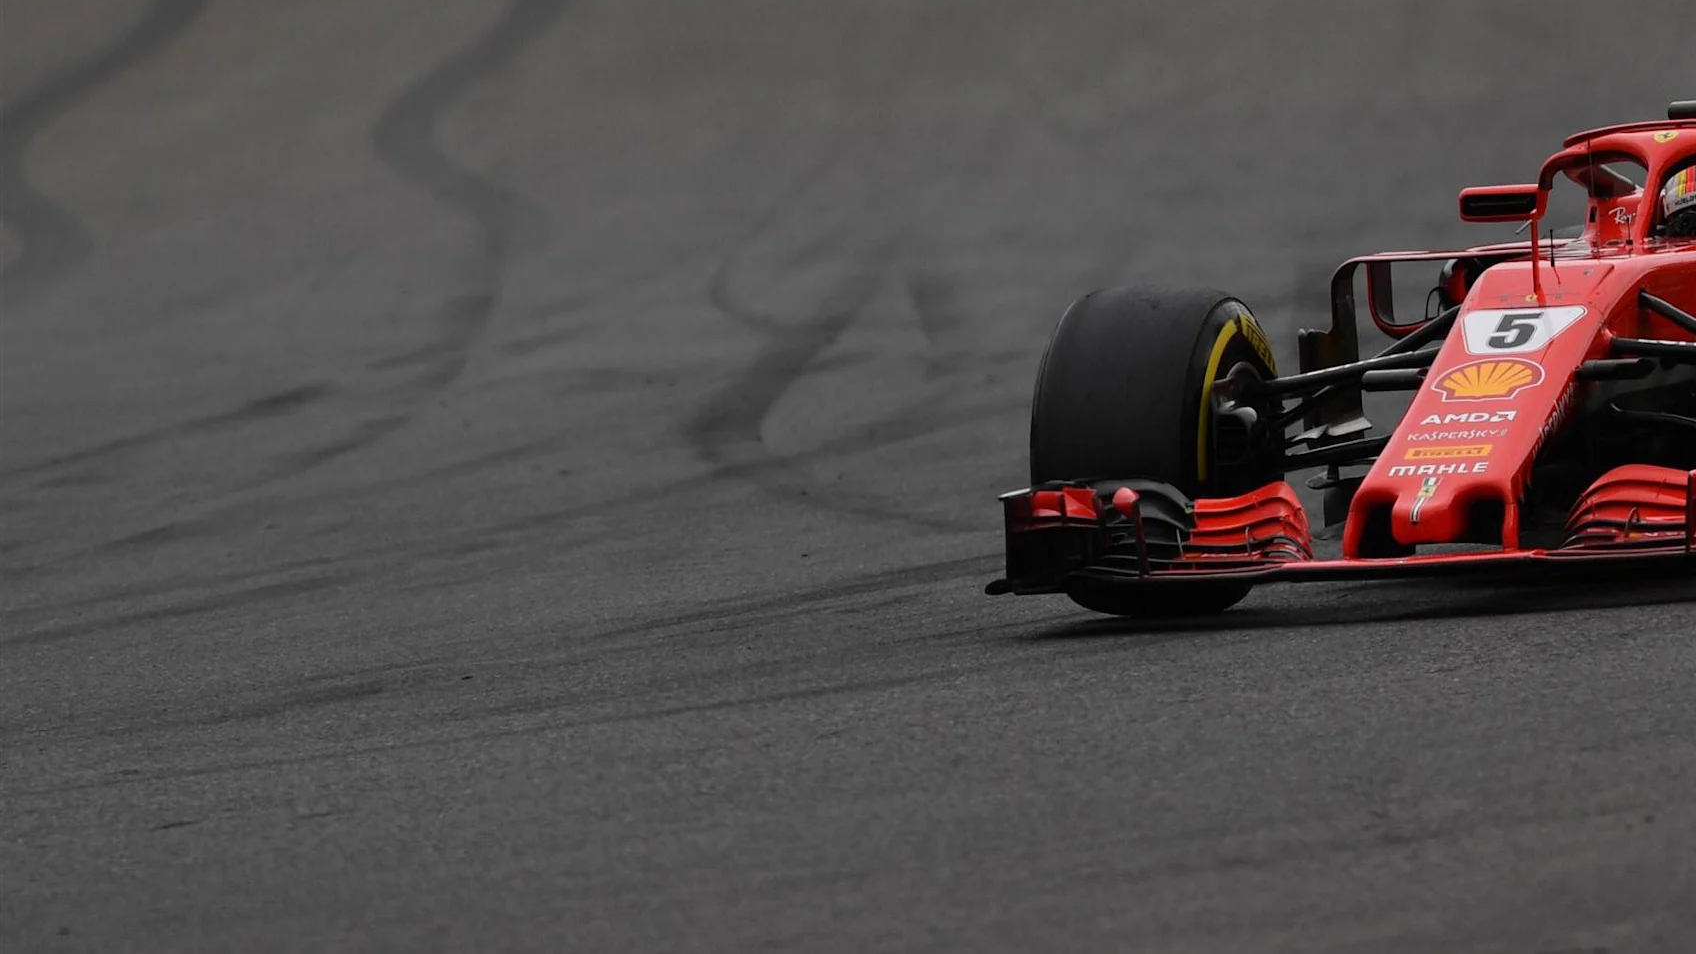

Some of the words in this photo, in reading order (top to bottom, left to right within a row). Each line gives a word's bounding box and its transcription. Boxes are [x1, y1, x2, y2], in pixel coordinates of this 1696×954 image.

[1487, 312, 1545, 349] 5
[1420, 412, 1490, 425] AMD
[1407, 428, 1499, 442] KASPERSKY
[1388, 462, 1489, 477] MAHLE
